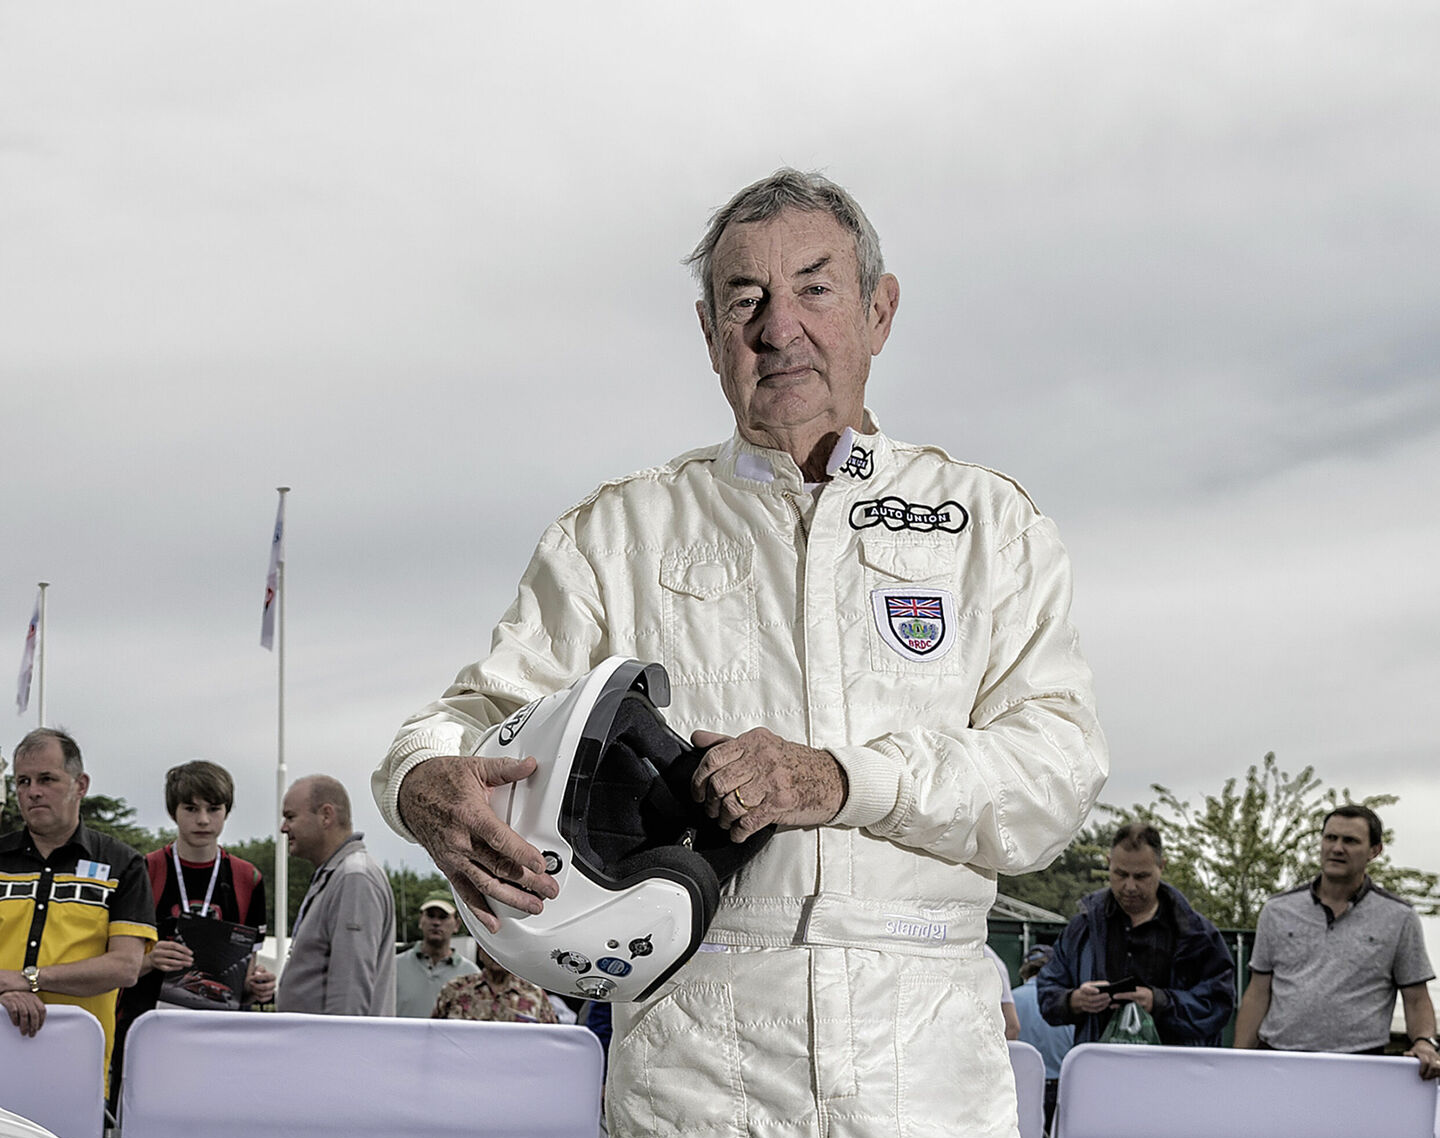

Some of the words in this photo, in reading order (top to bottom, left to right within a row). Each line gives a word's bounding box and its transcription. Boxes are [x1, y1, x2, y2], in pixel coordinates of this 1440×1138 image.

[870, 506, 903, 519] AUTO
[906, 512, 947, 525] UNION
[908, 639, 932, 650] BRDC
